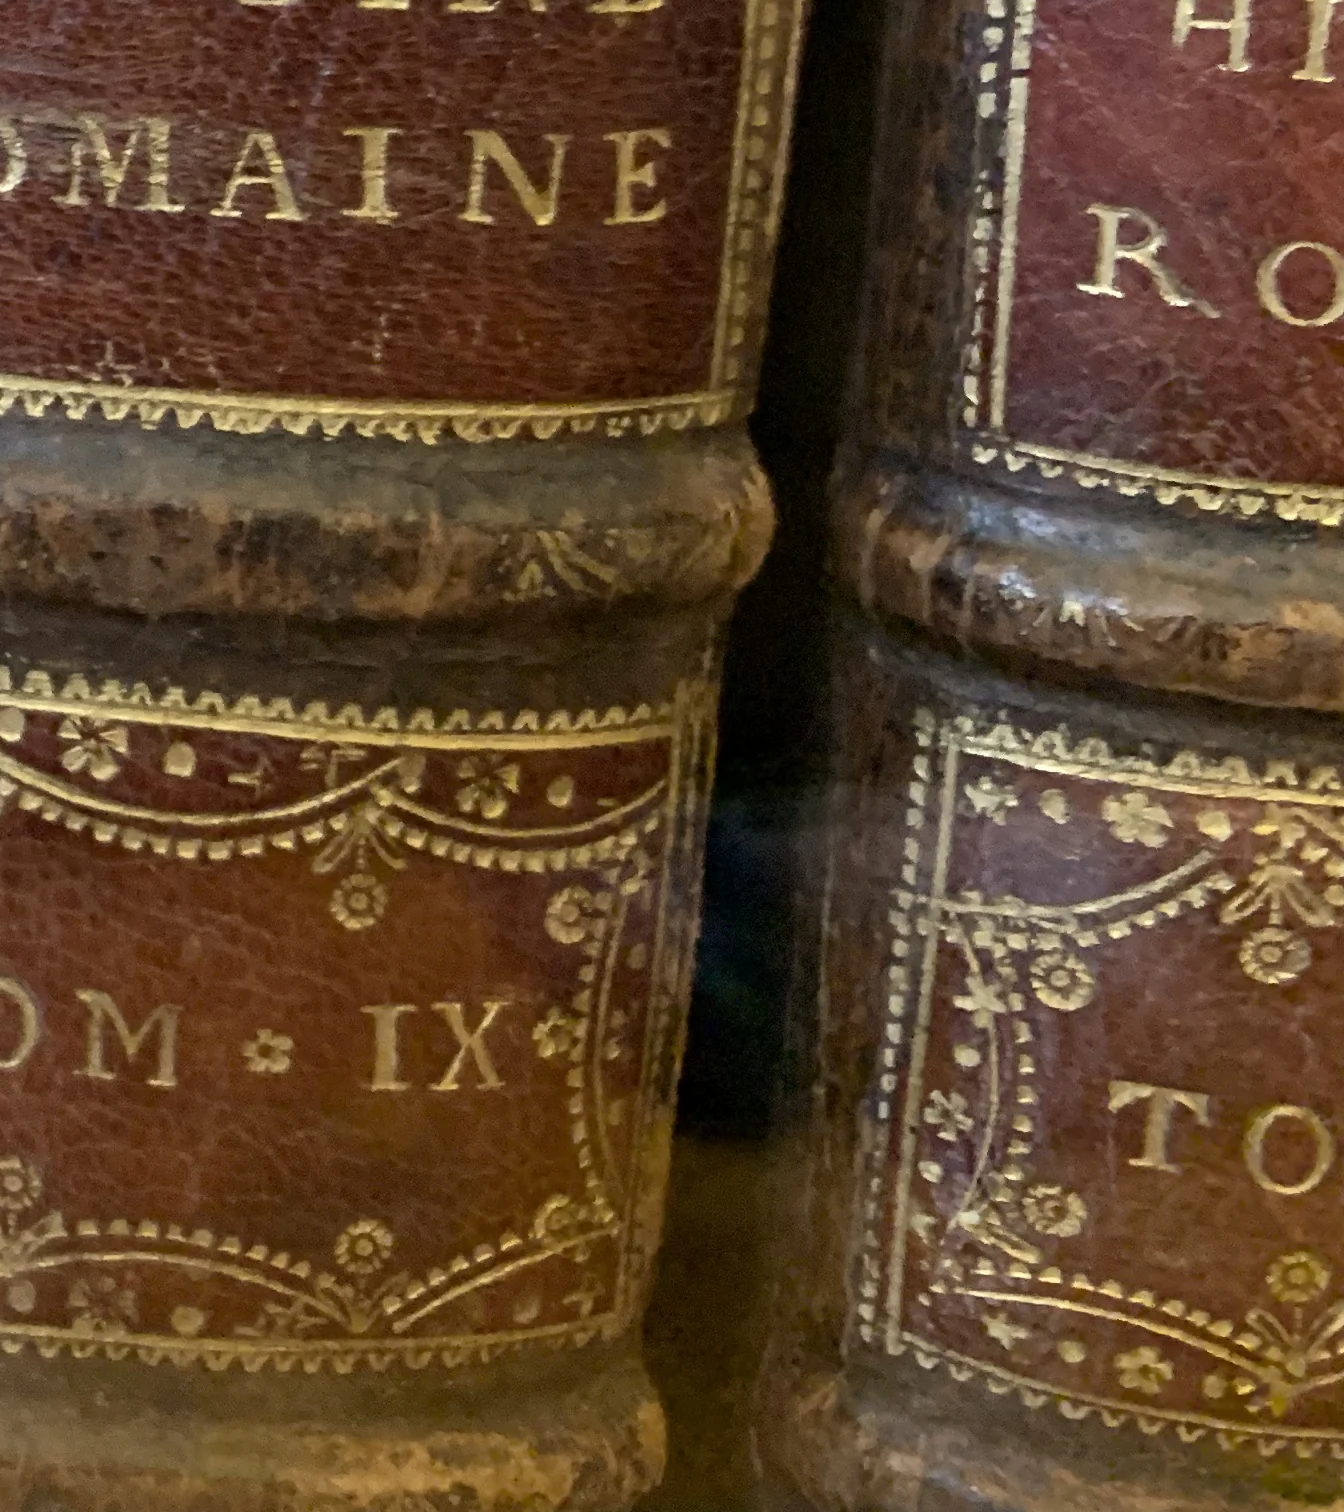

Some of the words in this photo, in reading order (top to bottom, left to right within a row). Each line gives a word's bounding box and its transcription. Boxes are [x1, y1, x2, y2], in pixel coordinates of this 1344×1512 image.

[1075, 202, 1344, 328] RO
[359, 999, 512, 1092] IX
[1107, 1079, 1334, 1196] TO
